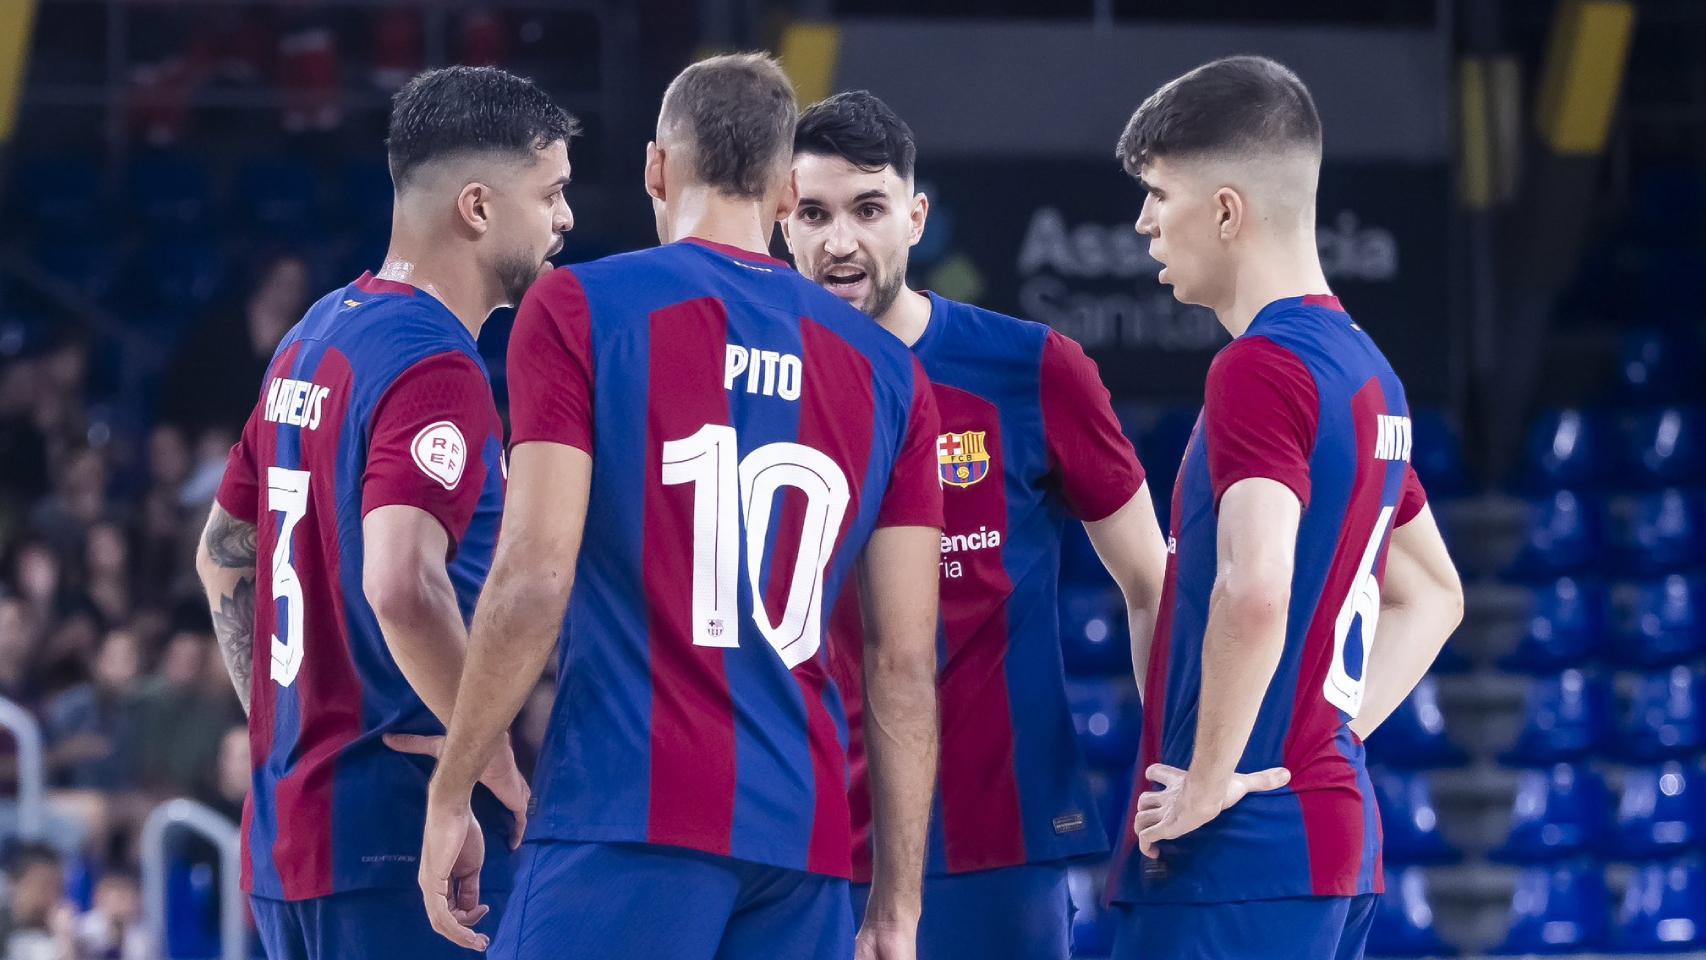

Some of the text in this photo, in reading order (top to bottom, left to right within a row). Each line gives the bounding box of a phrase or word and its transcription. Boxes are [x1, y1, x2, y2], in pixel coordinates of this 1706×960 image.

[264, 377, 330, 431] MATEUS
[724, 344, 802, 401] PITO
[267, 466, 311, 688] 3
[662, 423, 850, 671] 10
[1323, 506, 1394, 719] 6
